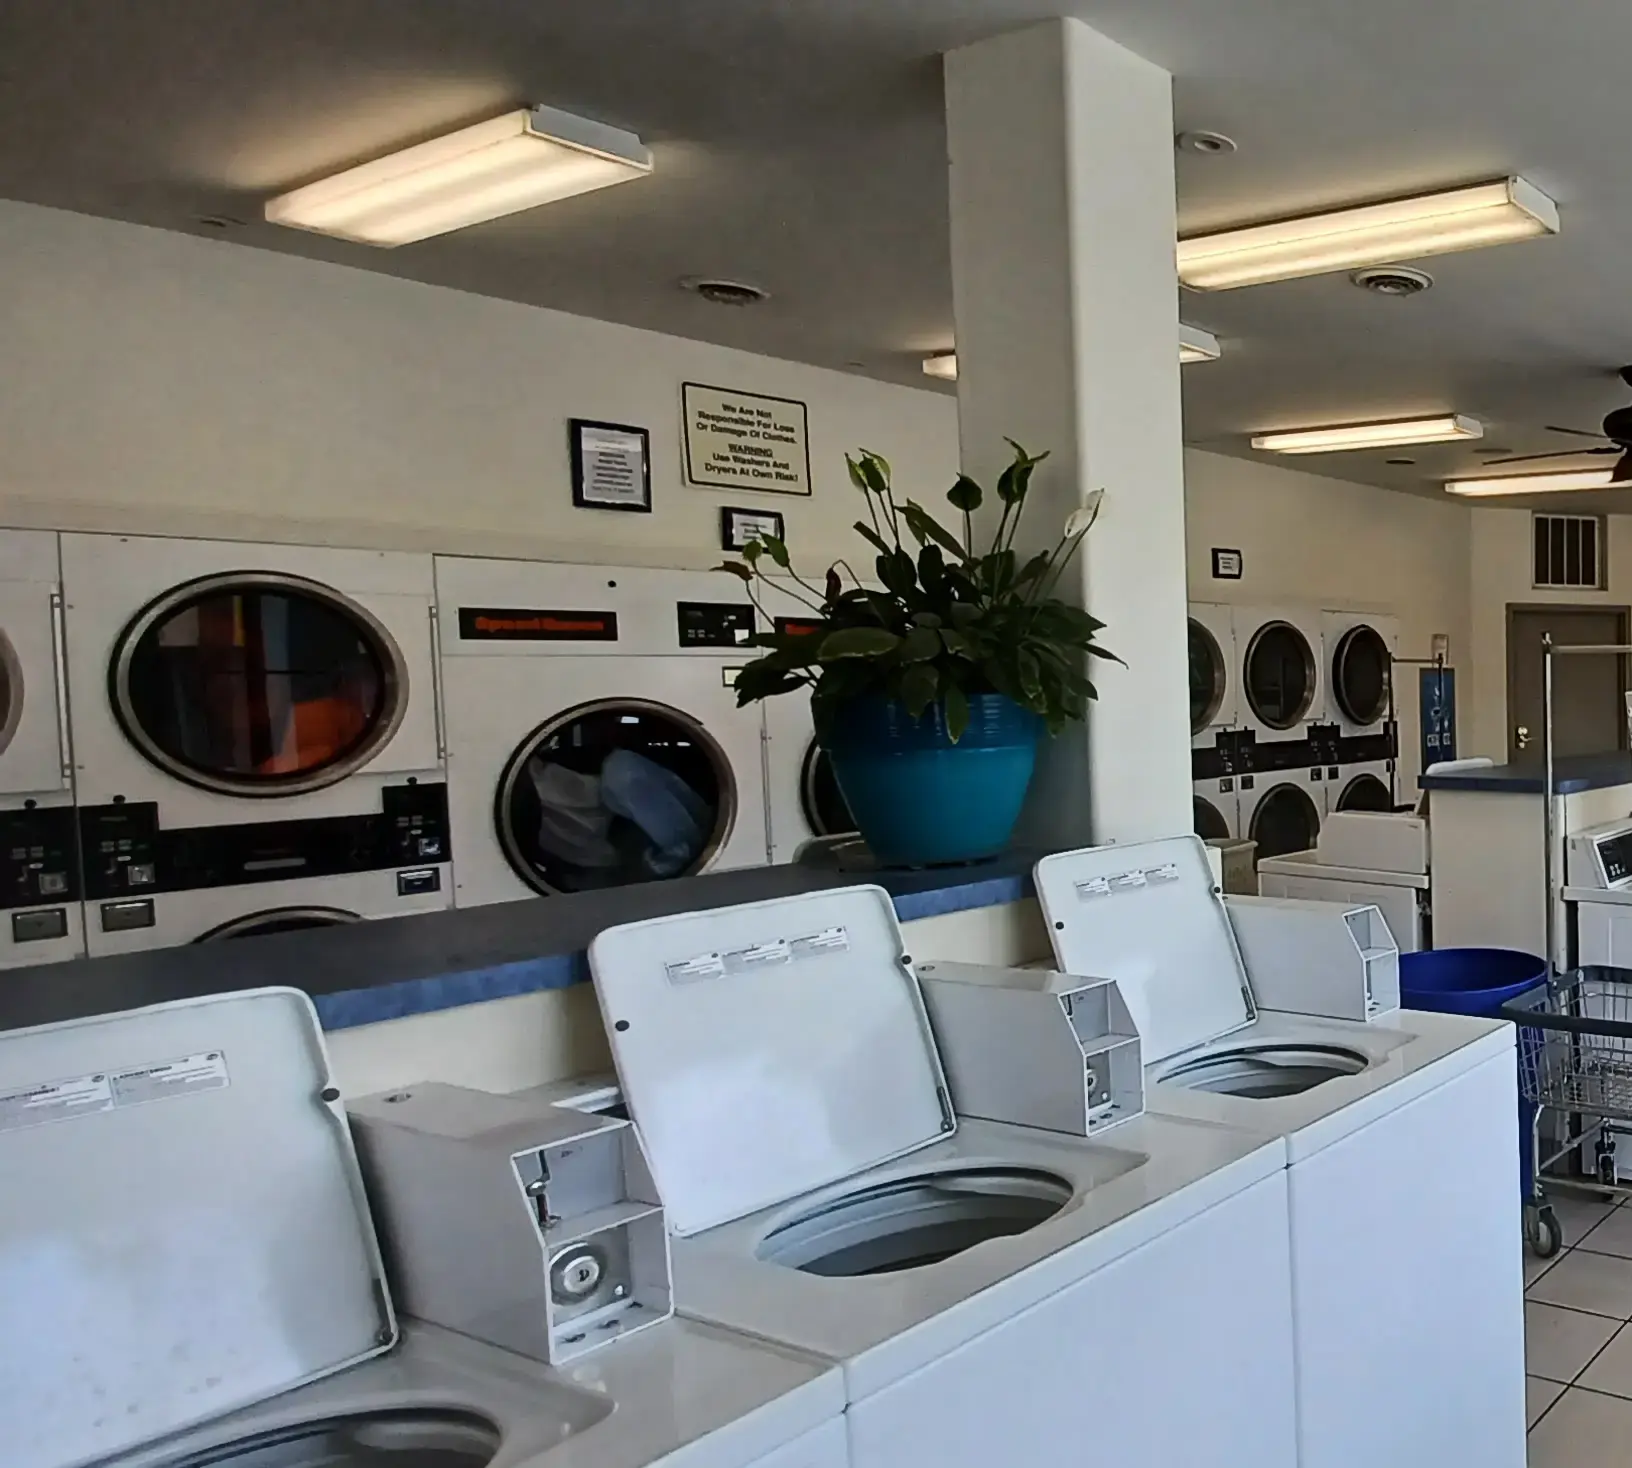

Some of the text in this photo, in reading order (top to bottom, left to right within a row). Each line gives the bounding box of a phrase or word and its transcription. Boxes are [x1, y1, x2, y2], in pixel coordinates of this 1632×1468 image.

[722, 403, 772, 419] We Are Not
[696, 421, 708, 431] Or
[711, 423, 747, 438] Damage
[749, 429, 760, 438] Of
[697, 410, 795, 433] Responsible For Loss
[728, 443, 774, 459] WARNING
[713, 452, 790, 470] Use Washers And
[704, 462, 738, 475] Dryers
[740, 467, 750, 476] At
[752, 468, 773, 479] Own
